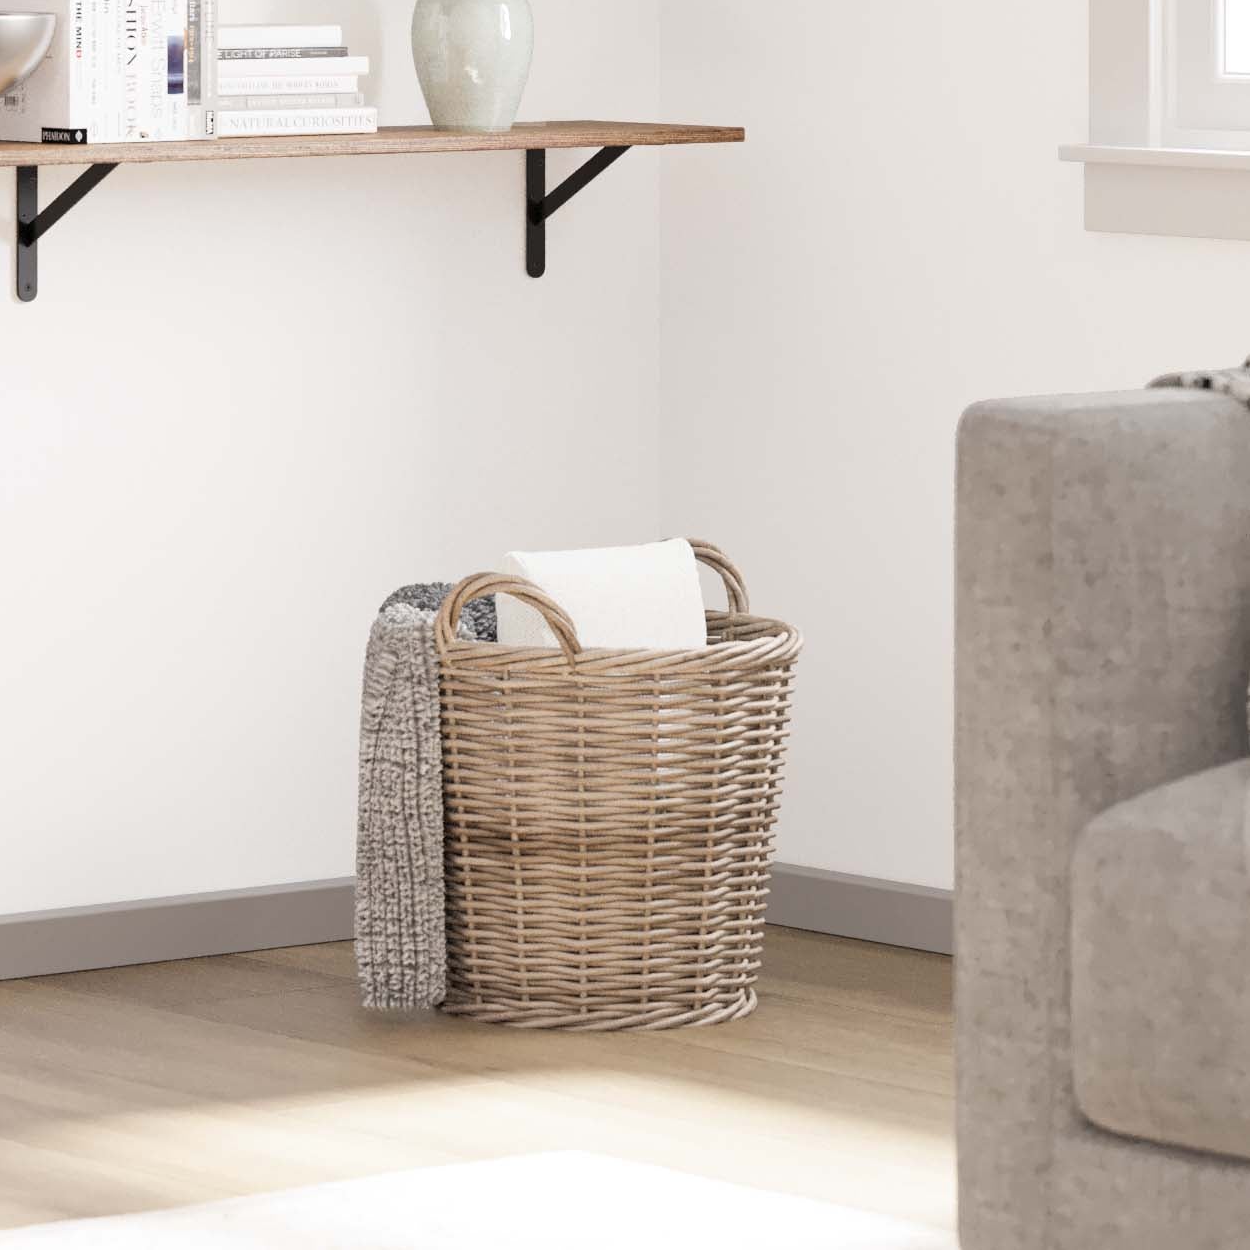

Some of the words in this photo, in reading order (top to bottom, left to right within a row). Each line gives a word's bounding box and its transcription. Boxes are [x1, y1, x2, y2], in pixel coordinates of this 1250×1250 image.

[75, 1, 83, 23] THE
[150, 0, 167, 50] Erwitt
[75, 26, 83, 58] MIND
[224, 50, 254, 58] LIGHT
[254, 50, 267, 58] OF
[150, 58, 167, 118] Snaps
[230, 117, 290, 128] NATURAL
[293, 115, 375, 127] CURIOSITIES
[43, 131, 71, 142] PHAIDON
